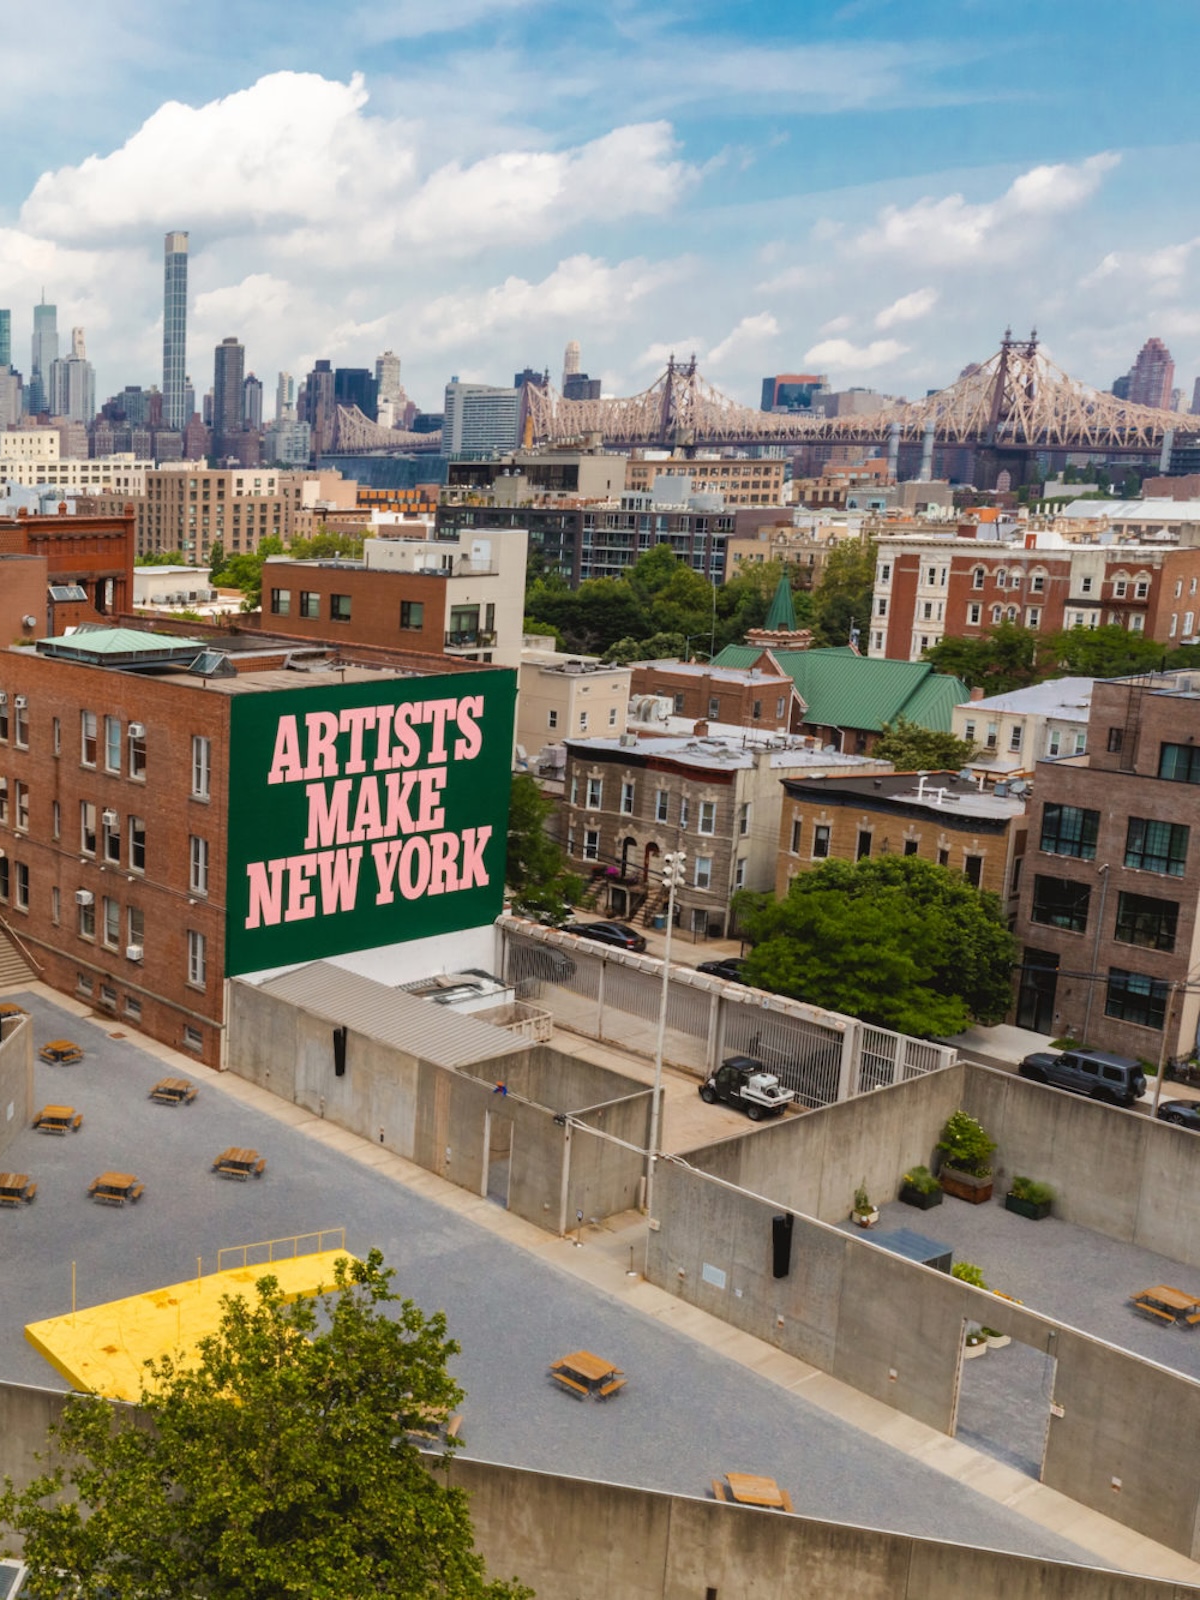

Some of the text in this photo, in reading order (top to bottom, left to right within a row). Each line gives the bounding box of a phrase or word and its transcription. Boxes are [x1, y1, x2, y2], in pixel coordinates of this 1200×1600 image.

[267, 695, 484, 785] ARTISTS
[304, 766, 447, 850] MAKE
[245, 825, 492, 929] NEW YORK
